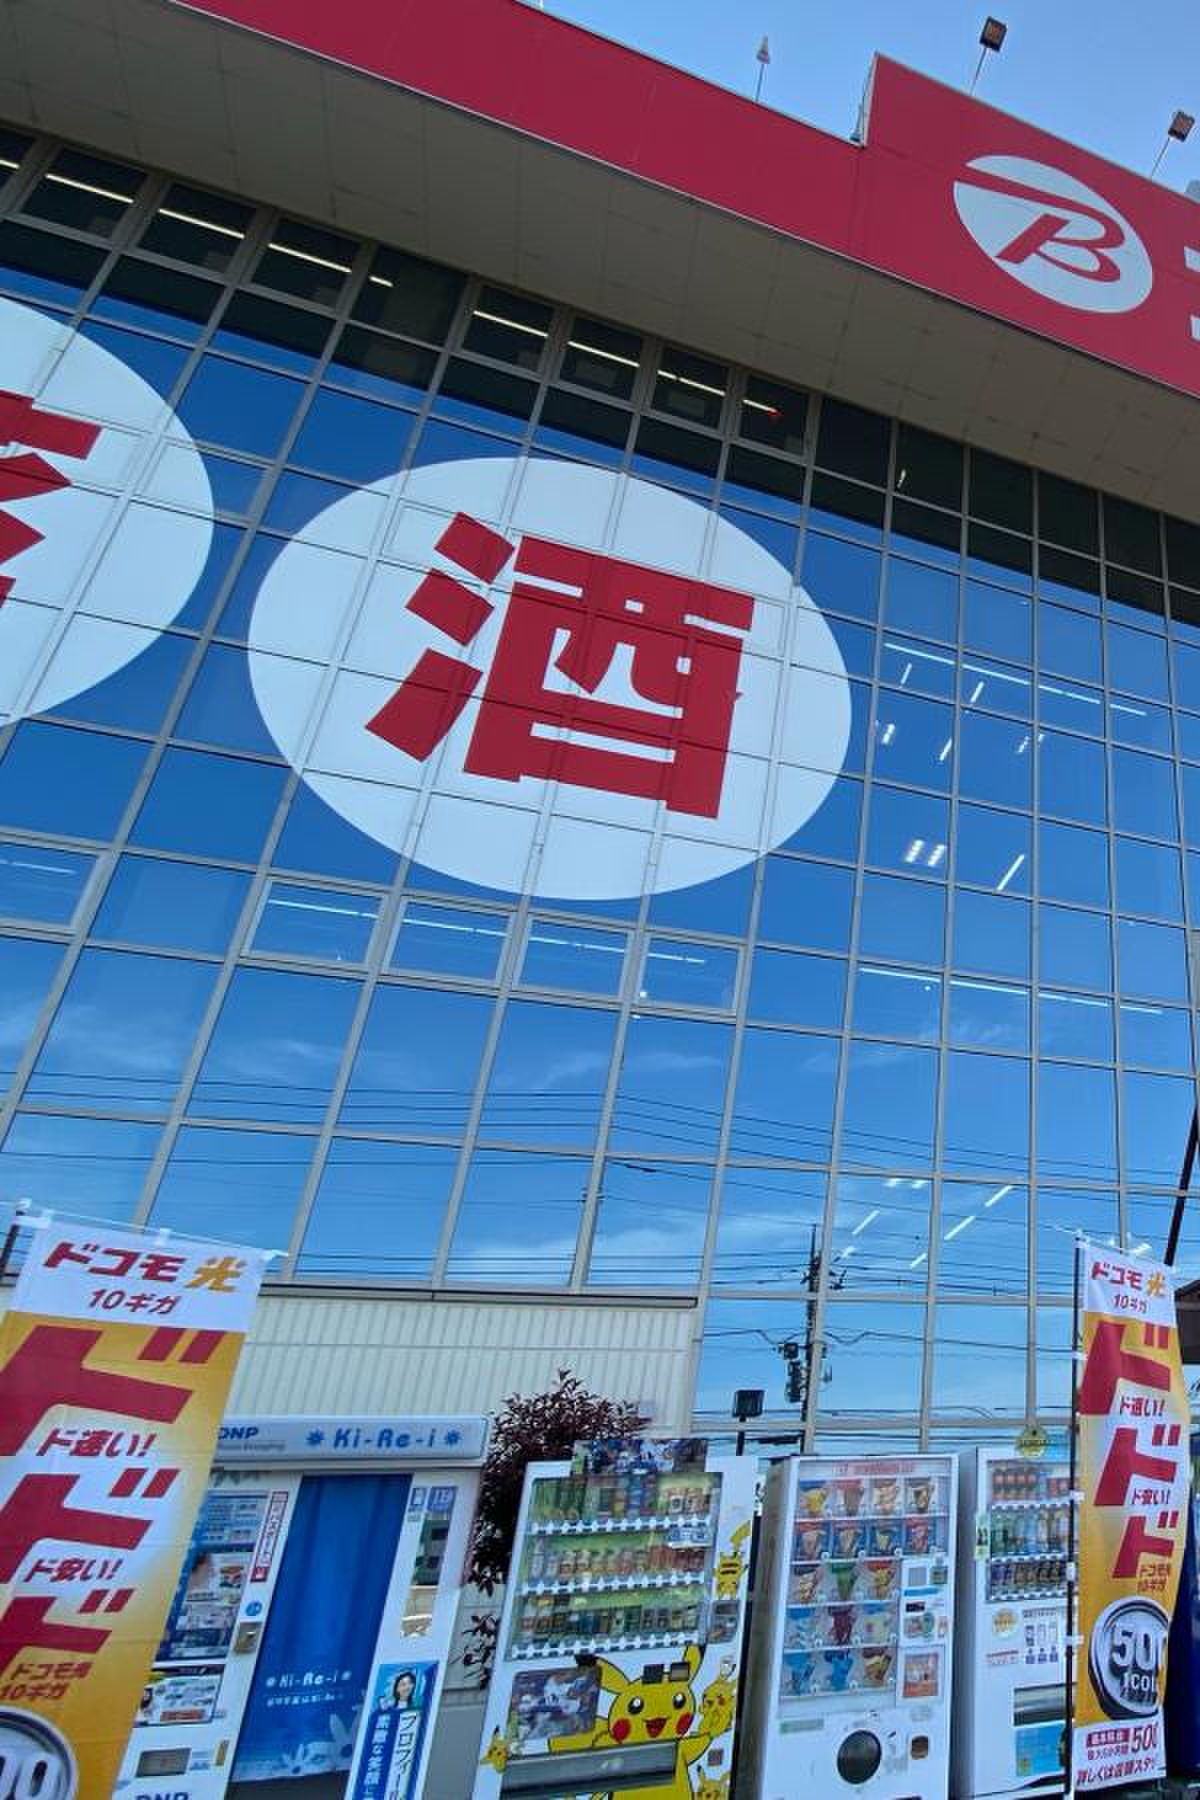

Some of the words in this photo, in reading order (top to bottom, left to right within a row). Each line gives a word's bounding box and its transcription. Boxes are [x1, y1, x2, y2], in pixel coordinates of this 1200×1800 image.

[364, 510, 756, 820] 酒
[44, 1240, 248, 1294] ドコモ光
[1091, 1261, 1166, 1297] ドコモ光
[88, 1288, 182, 1316] 10ギガ
[1113, 1294, 1148, 1314] 10ギガ
